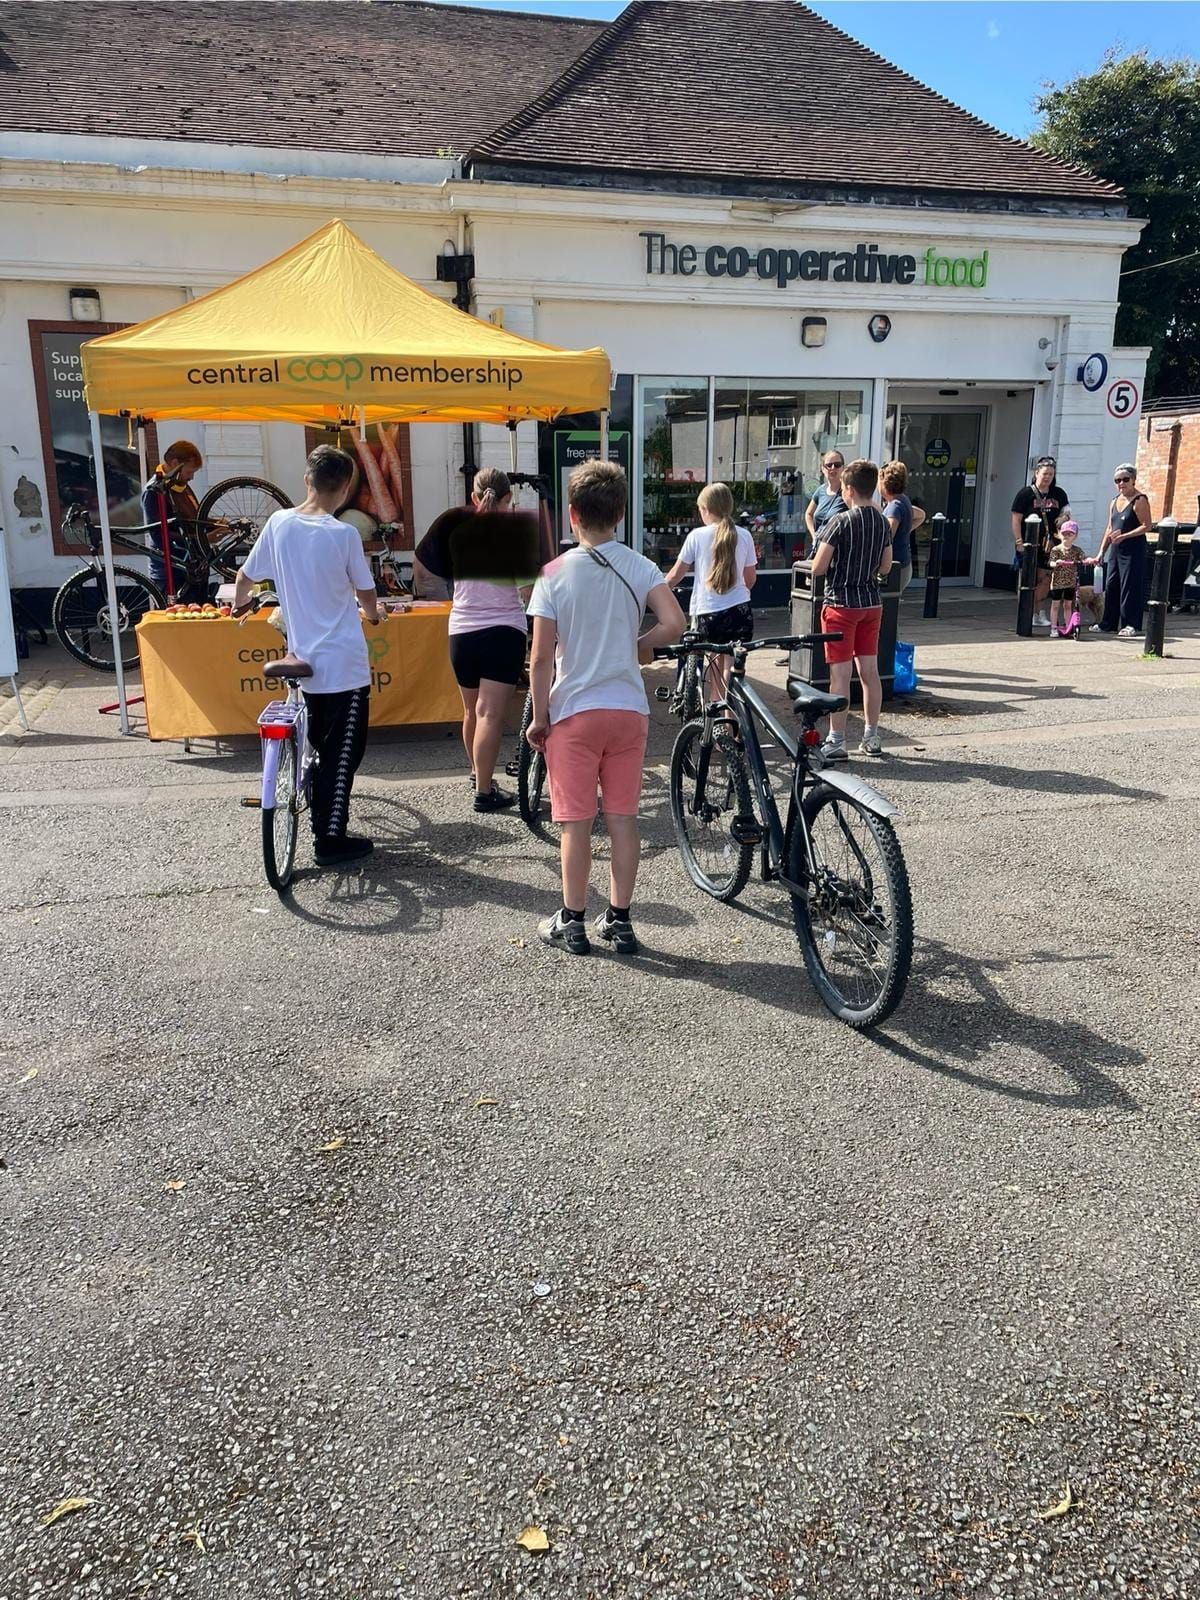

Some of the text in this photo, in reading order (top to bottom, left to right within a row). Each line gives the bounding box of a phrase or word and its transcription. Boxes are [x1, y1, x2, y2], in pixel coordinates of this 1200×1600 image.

[639, 231, 989, 288] The co-operative food
[187, 359, 280, 384] central
[370, 359, 523, 391] membership
[1114, 387, 1130, 413] 5
[566, 447, 585, 458] free
